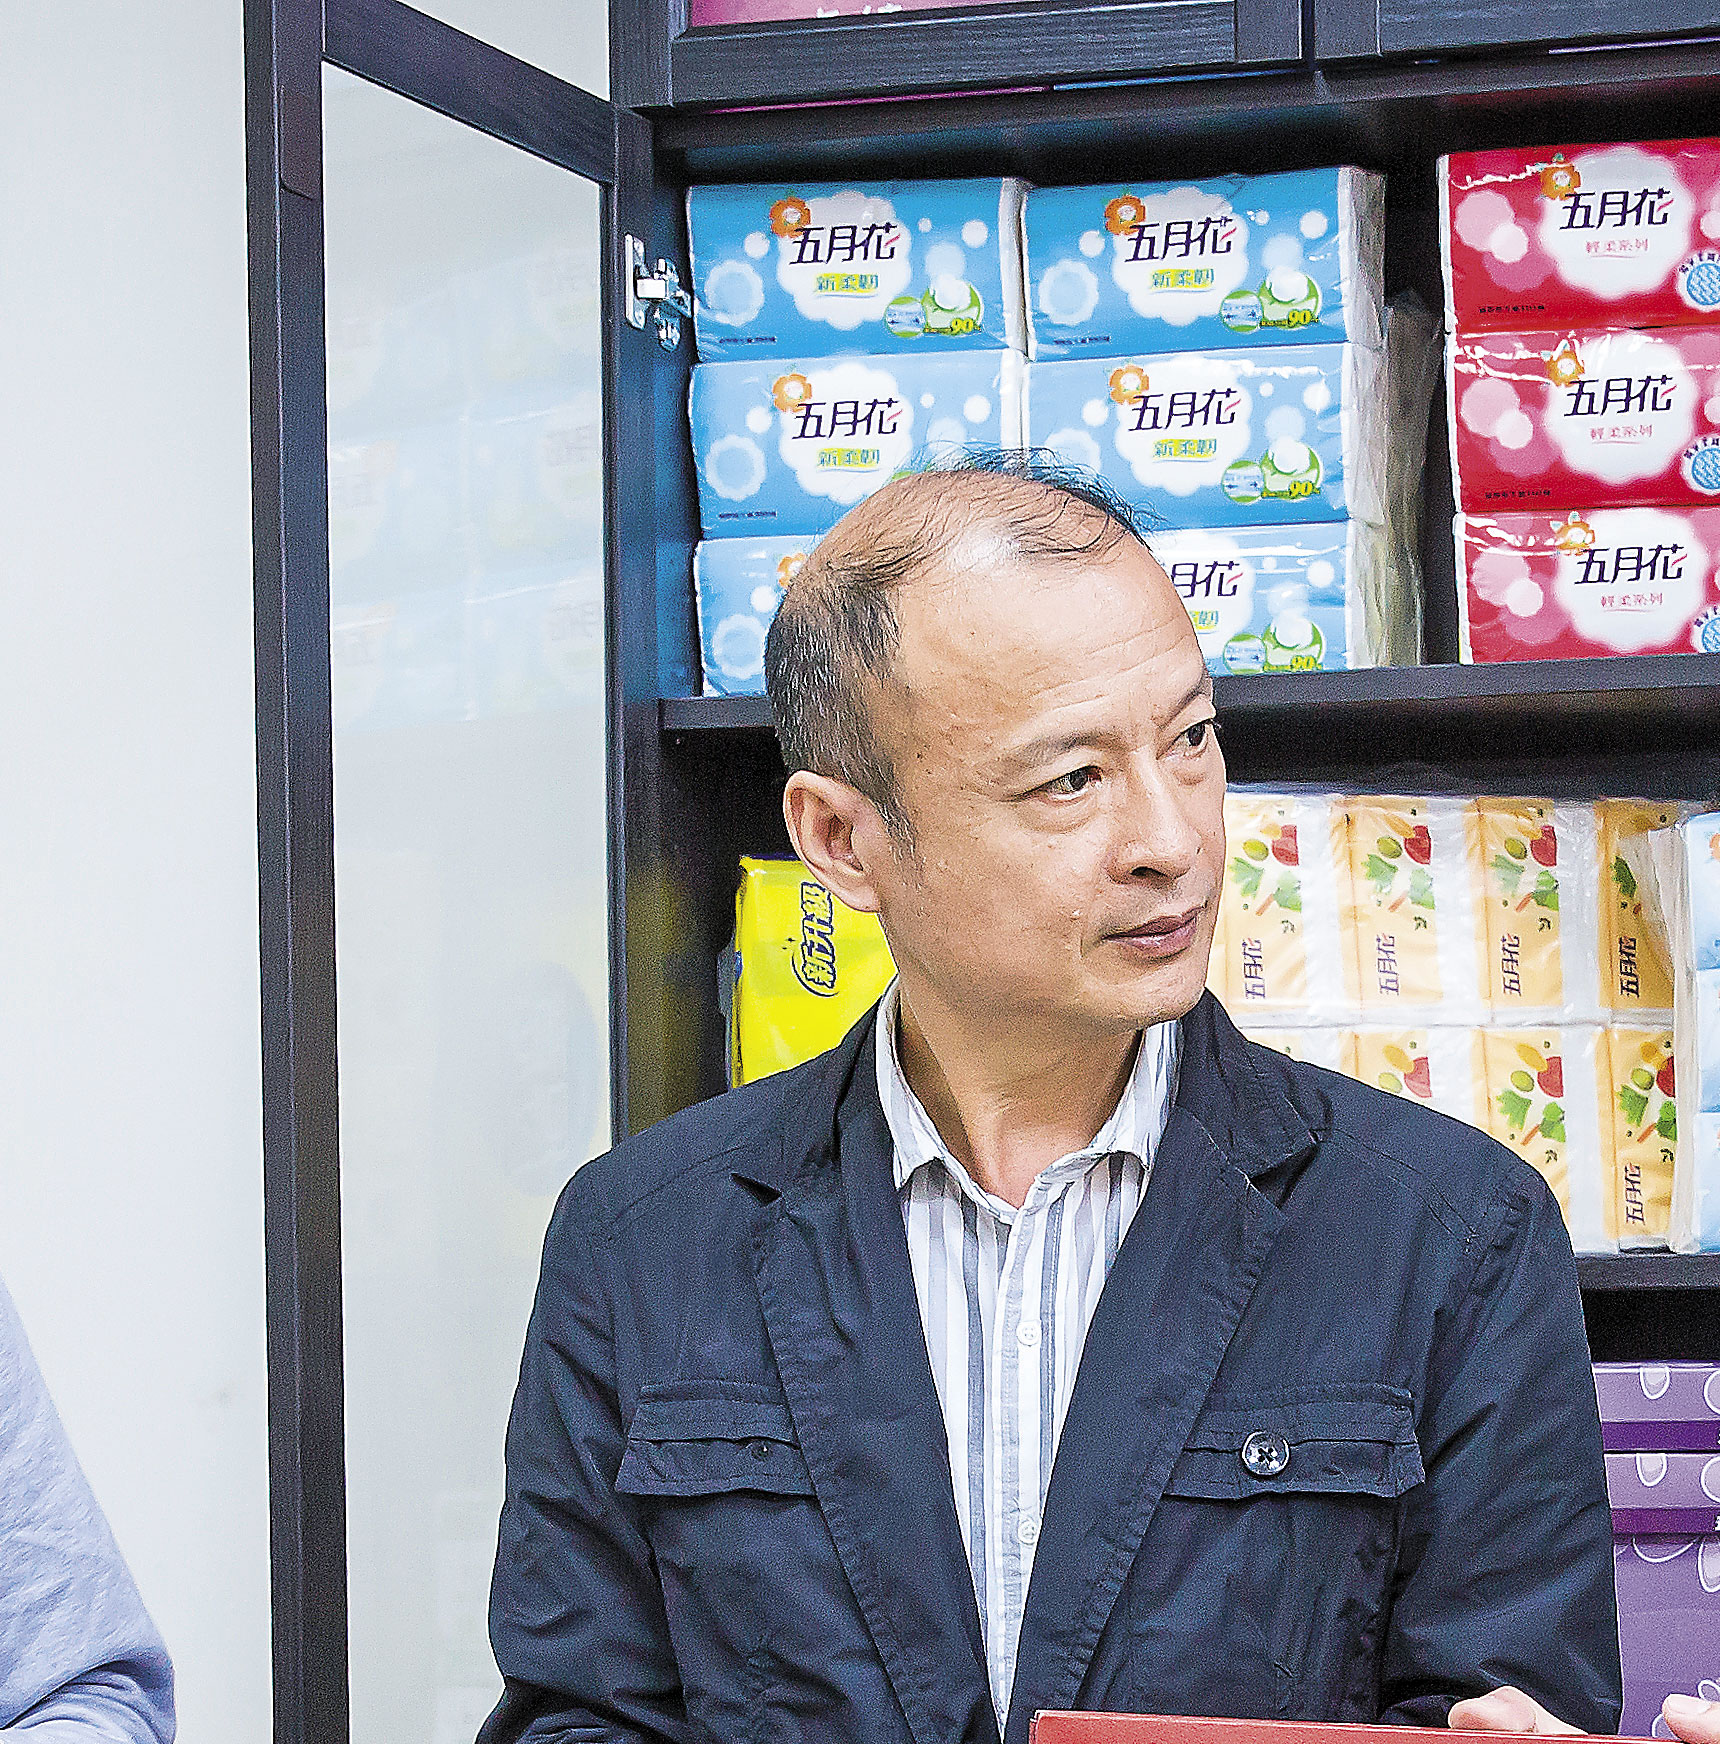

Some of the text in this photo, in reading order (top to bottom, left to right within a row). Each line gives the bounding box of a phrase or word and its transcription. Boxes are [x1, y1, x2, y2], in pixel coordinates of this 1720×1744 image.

[1559, 188, 1673, 230] 五月花
[789, 223, 900, 264] 五月花
[1124, 219, 1235, 264] 五月花
[1128, 389, 1239, 431] 五月花
[1564, 375, 1677, 417] 五月花
[791, 399, 902, 439] 五月花
[1171, 561, 1243, 600] 月花
[1574, 544, 1687, 585] 五月花
[1242, 937, 1266, 1000] 五月花
[1376, 934, 1400, 996] 五月花
[1500, 935, 1522, 996] 五月花
[1617, 936, 1640, 998] 五月花
[1626, 1162, 1647, 1226] 五月花
